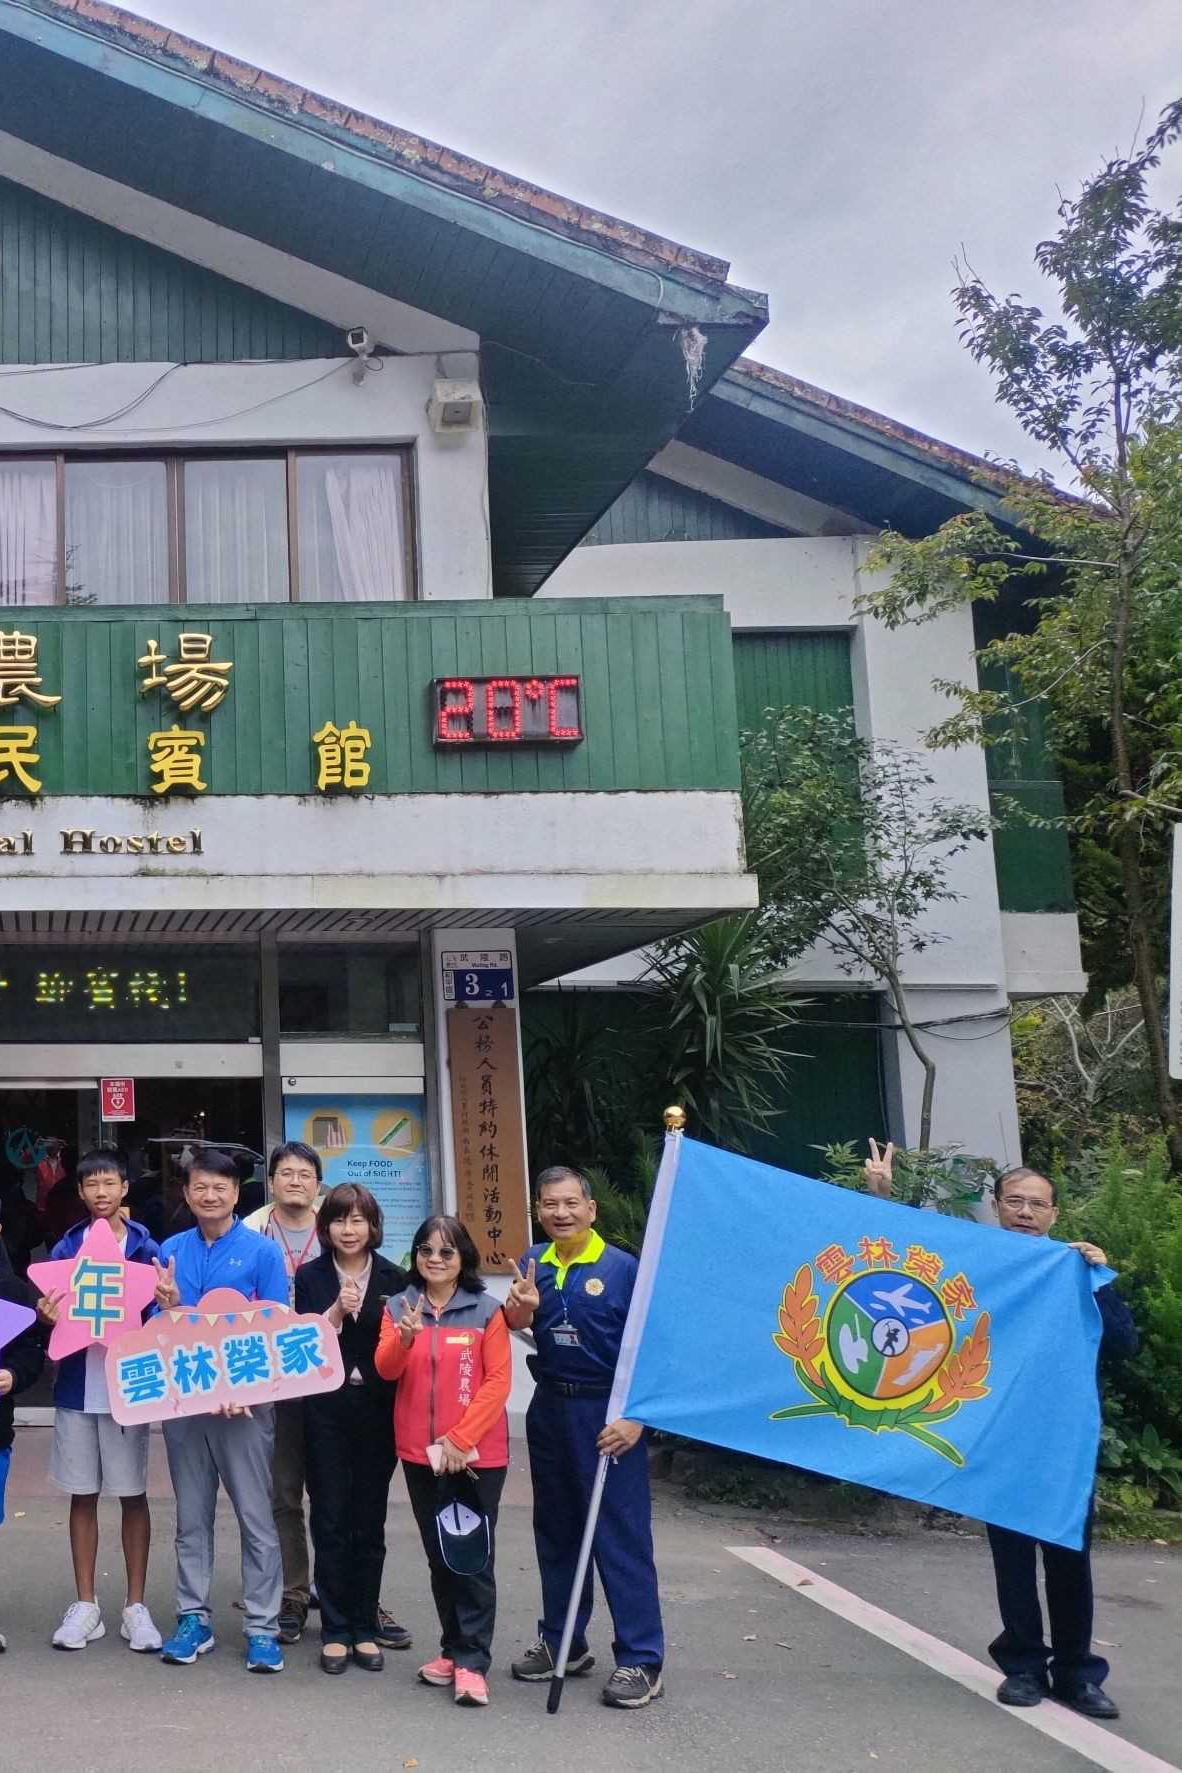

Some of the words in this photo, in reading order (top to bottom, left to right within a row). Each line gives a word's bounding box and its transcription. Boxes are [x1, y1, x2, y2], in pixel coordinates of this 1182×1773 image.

[59, 827, 205, 855] Hostel
[347, 1160, 368, 1169] Keep
[369, 1160, 393, 1168] FOOD
[72, 1259, 121, 1337] 年
[814, 1235, 979, 1321] 雲林榮家
[119, 1325, 325, 1405] 雲林榮家
[458, 1349, 475, 1408] 武陵農場
